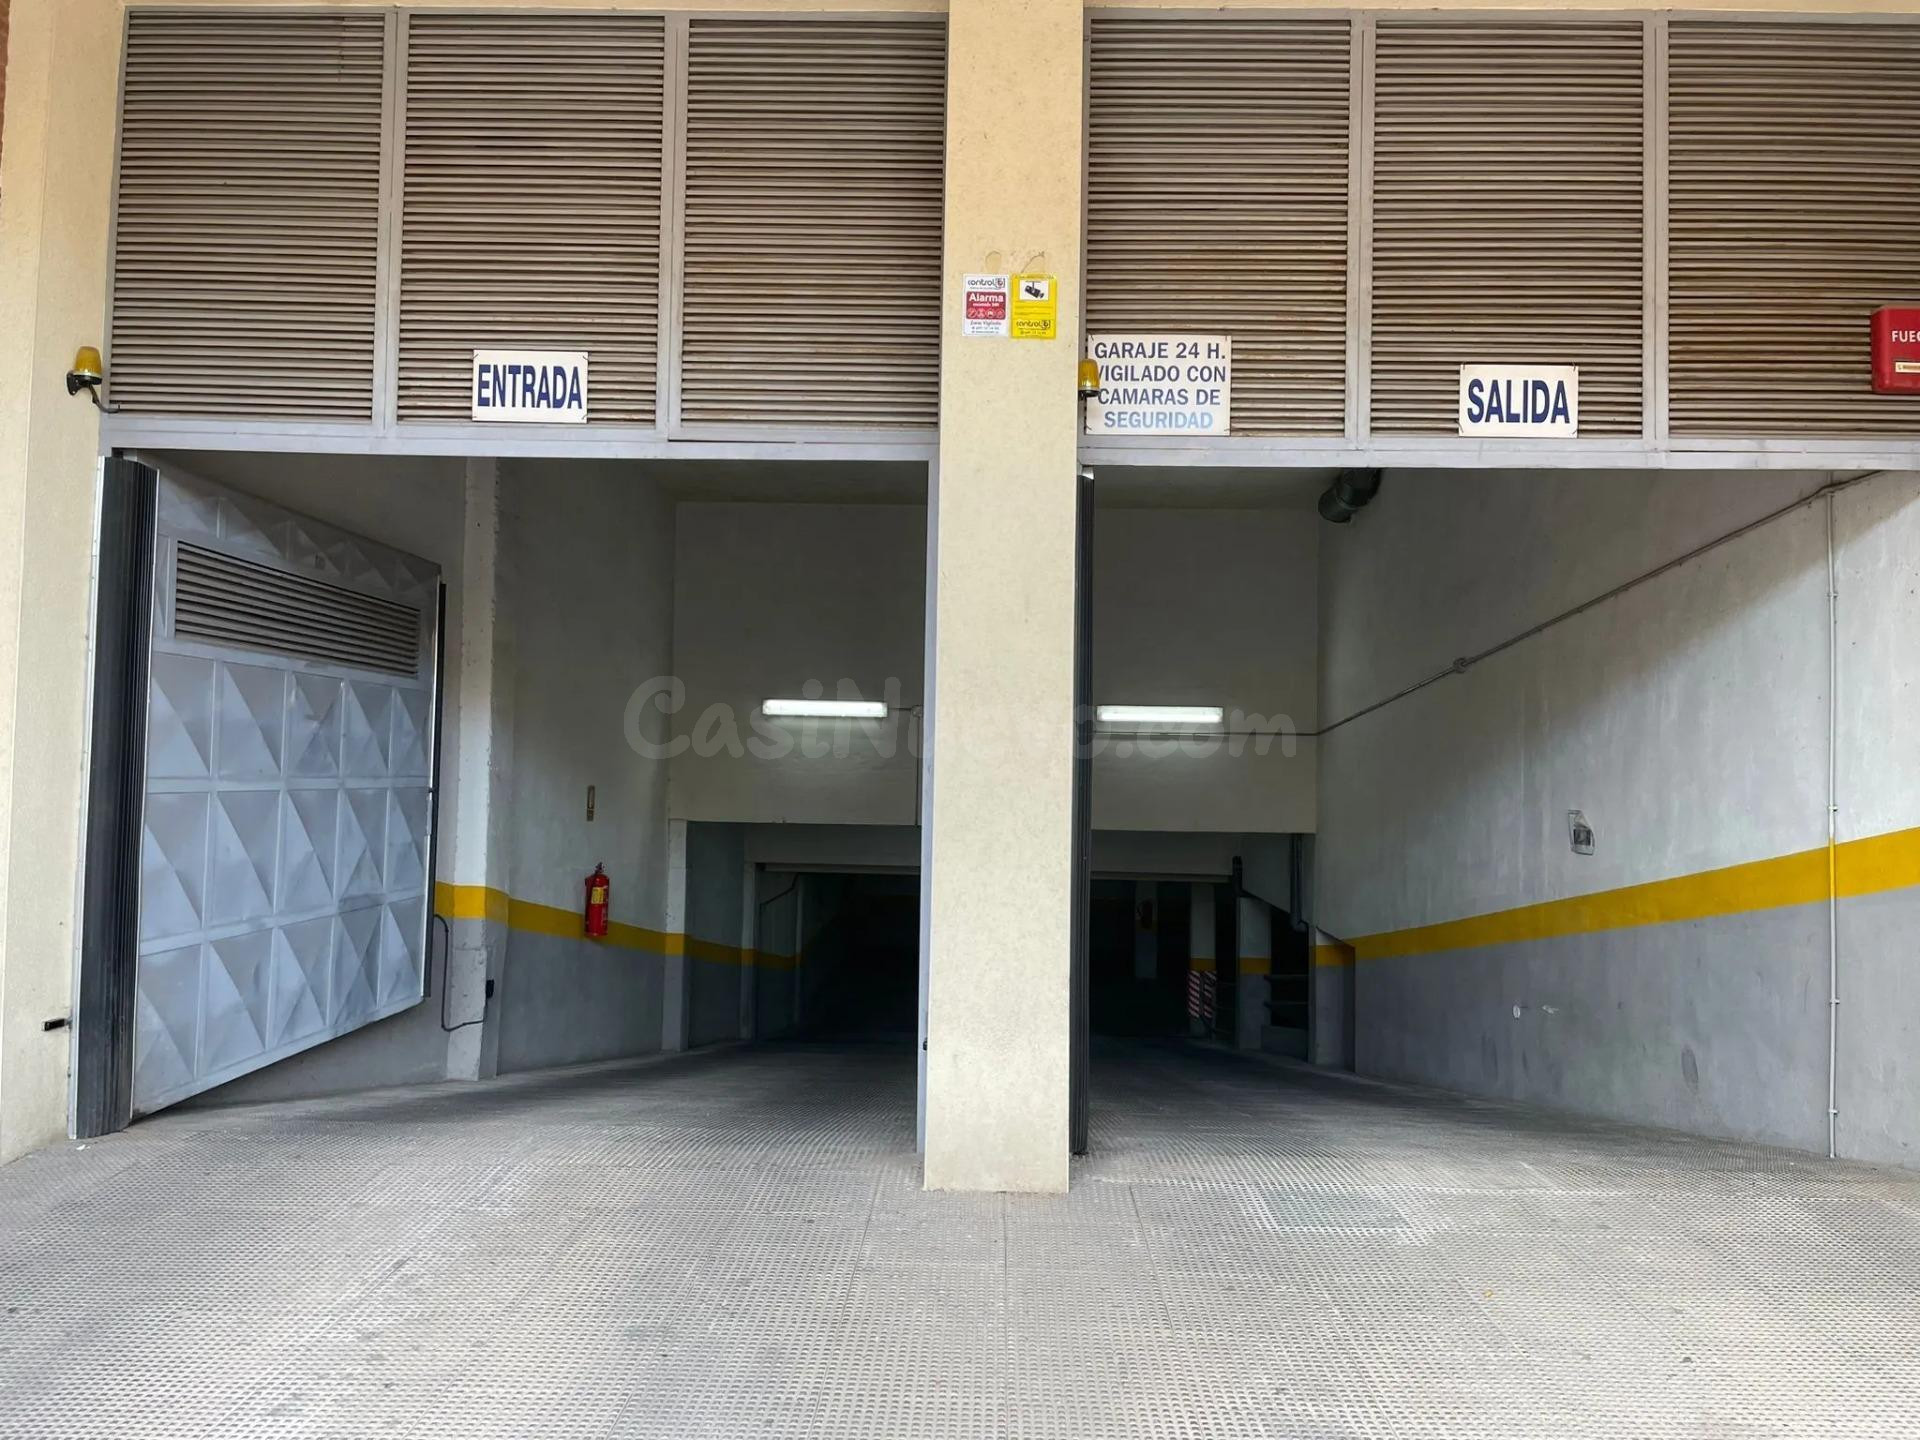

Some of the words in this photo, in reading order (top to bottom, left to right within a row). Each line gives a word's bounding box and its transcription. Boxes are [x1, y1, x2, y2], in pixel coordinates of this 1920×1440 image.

[969, 293, 1004, 302] Alarma
[1094, 342, 1169, 359] GARAJE
[1175, 342, 1200, 359] 24
[1207, 343, 1226, 360] H.
[1187, 366, 1226, 382] CON
[477, 364, 583, 410] ENTRADA
[1098, 388, 1188, 405] CAMARAS
[1196, 389, 1221, 405] DE
[1467, 378, 1571, 424] SALIDA
[1104, 411, 1213, 429] SEGURIDAD
